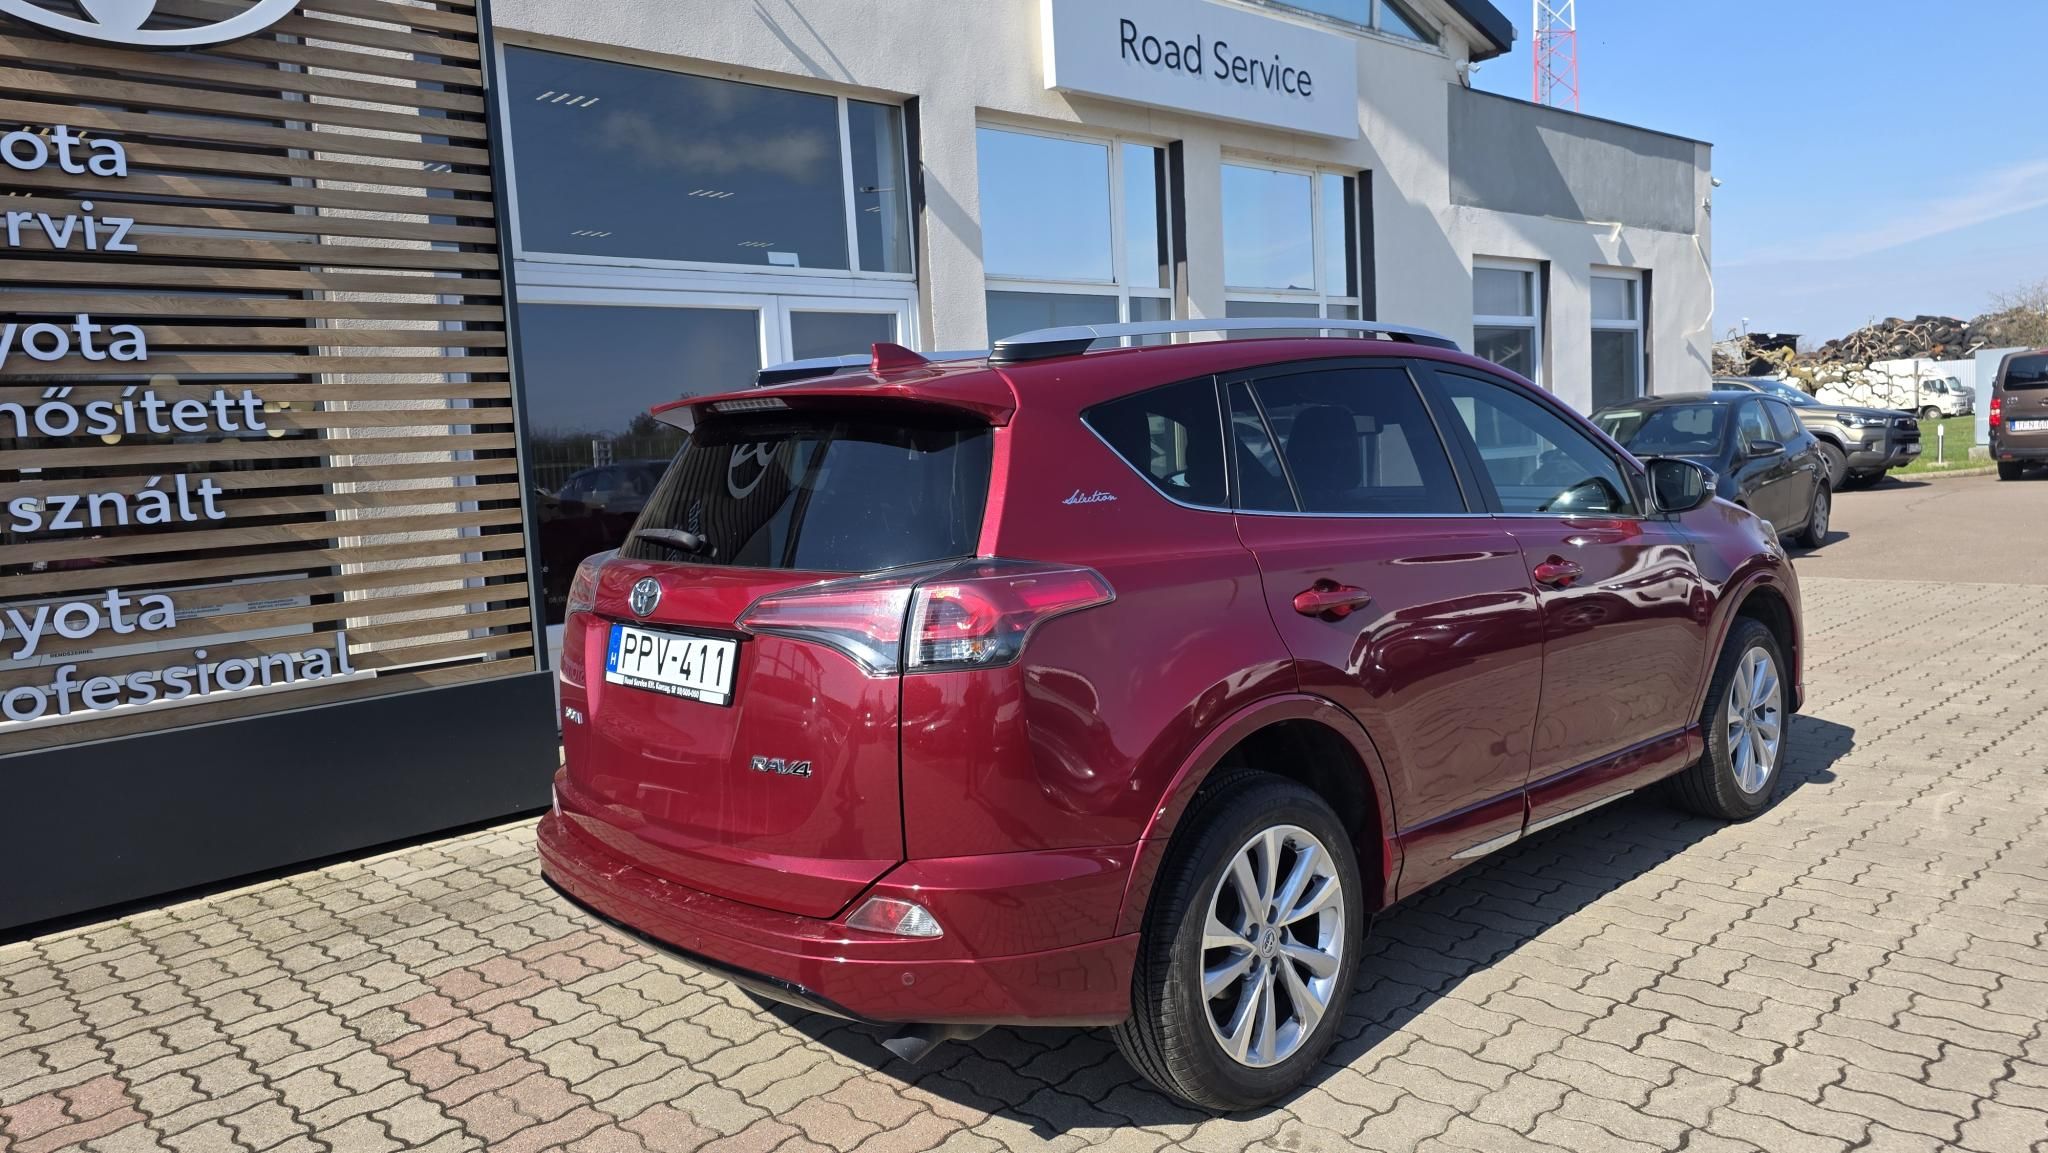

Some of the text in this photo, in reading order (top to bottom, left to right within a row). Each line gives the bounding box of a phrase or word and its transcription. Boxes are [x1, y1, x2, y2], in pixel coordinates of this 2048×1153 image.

[1119, 18, 1312, 97] Road Service
[5, 200, 139, 252] rviz
[0, 386, 266, 438] nősített
[1062, 489, 1117, 505] Selection
[0, 588, 176, 661] yota
[610, 652, 617, 665] H
[622, 633, 725, 687] PPV-411
[751, 755, 813, 778] RAV4
